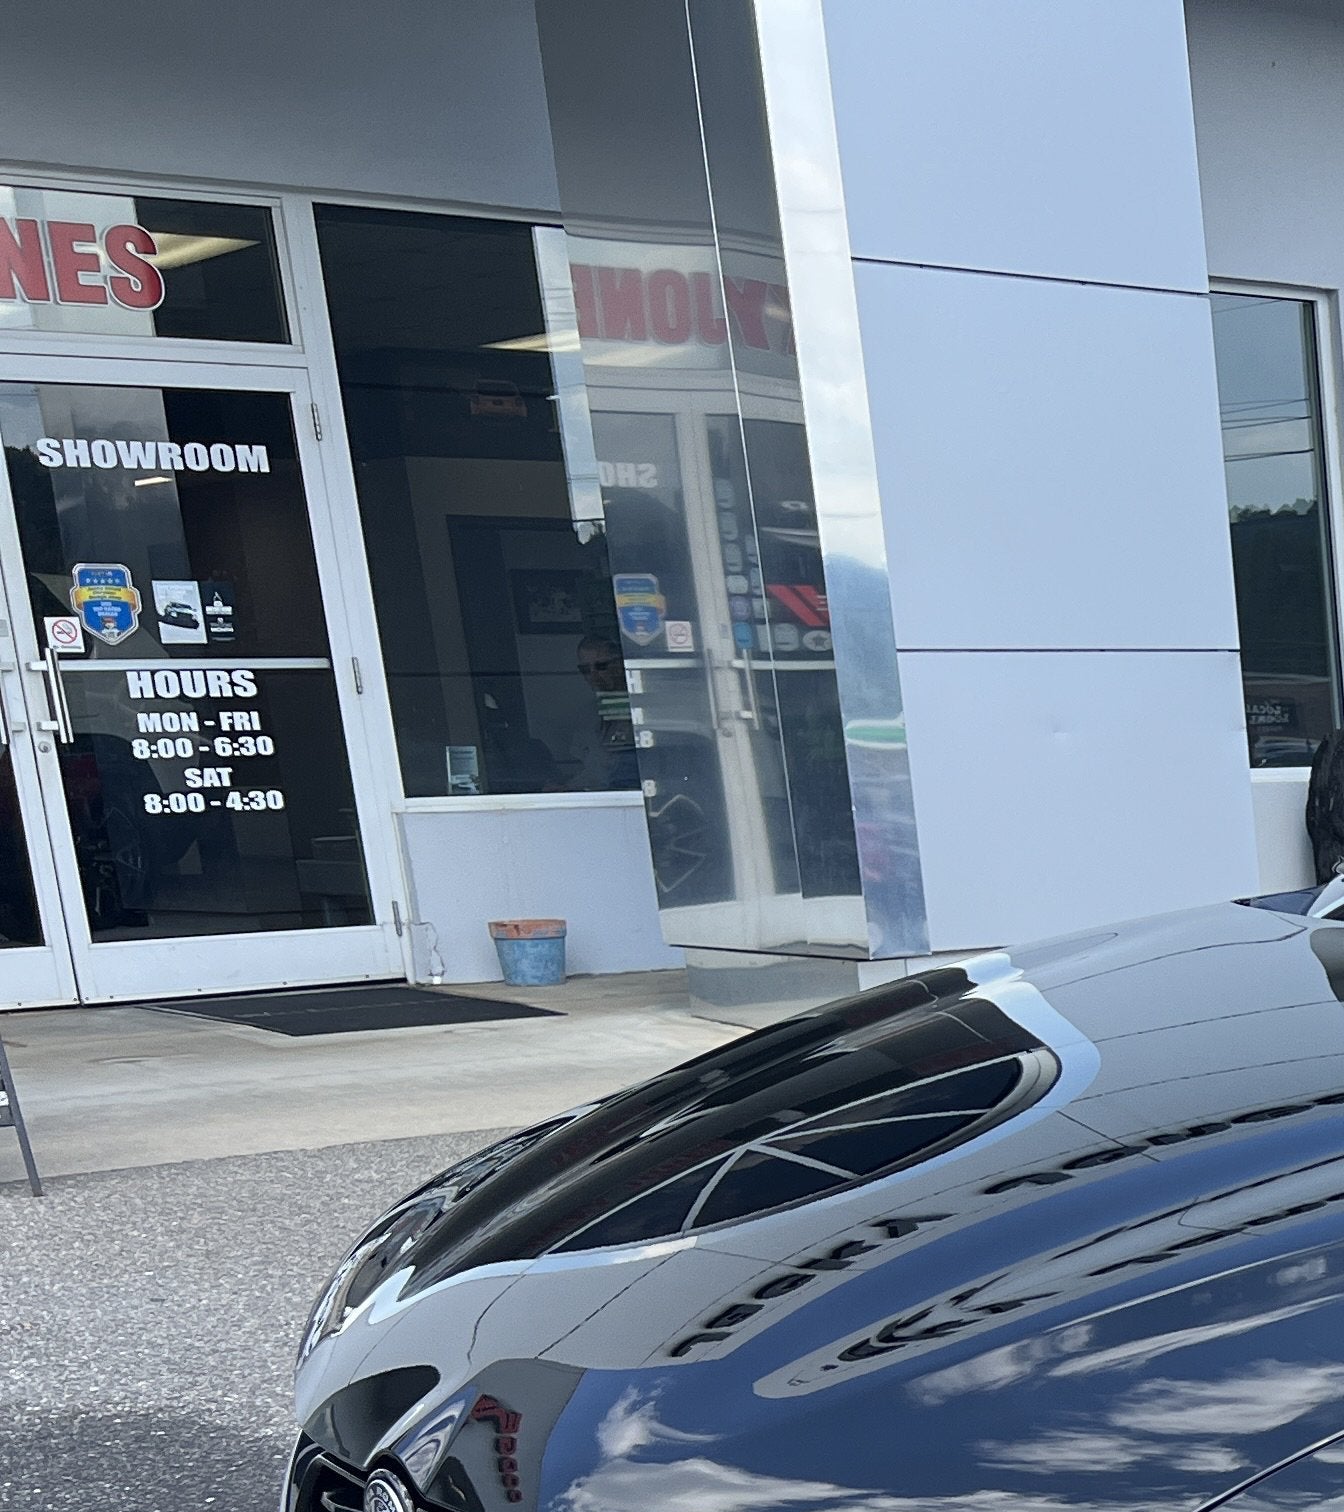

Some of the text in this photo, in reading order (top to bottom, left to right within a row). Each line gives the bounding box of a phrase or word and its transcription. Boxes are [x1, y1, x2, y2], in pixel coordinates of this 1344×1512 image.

[36, 437, 271, 473] SHOWROOM
[126, 670, 258, 699] HOURS
[136, 712, 200, 733] MON
[219, 711, 262, 731] FRI
[131, 737, 194, 760] 8:00
[213, 735, 275, 757] 6:30
[184, 767, 233, 788] SAT
[143, 792, 206, 814] 8:00
[225, 790, 285, 811] 4:30
